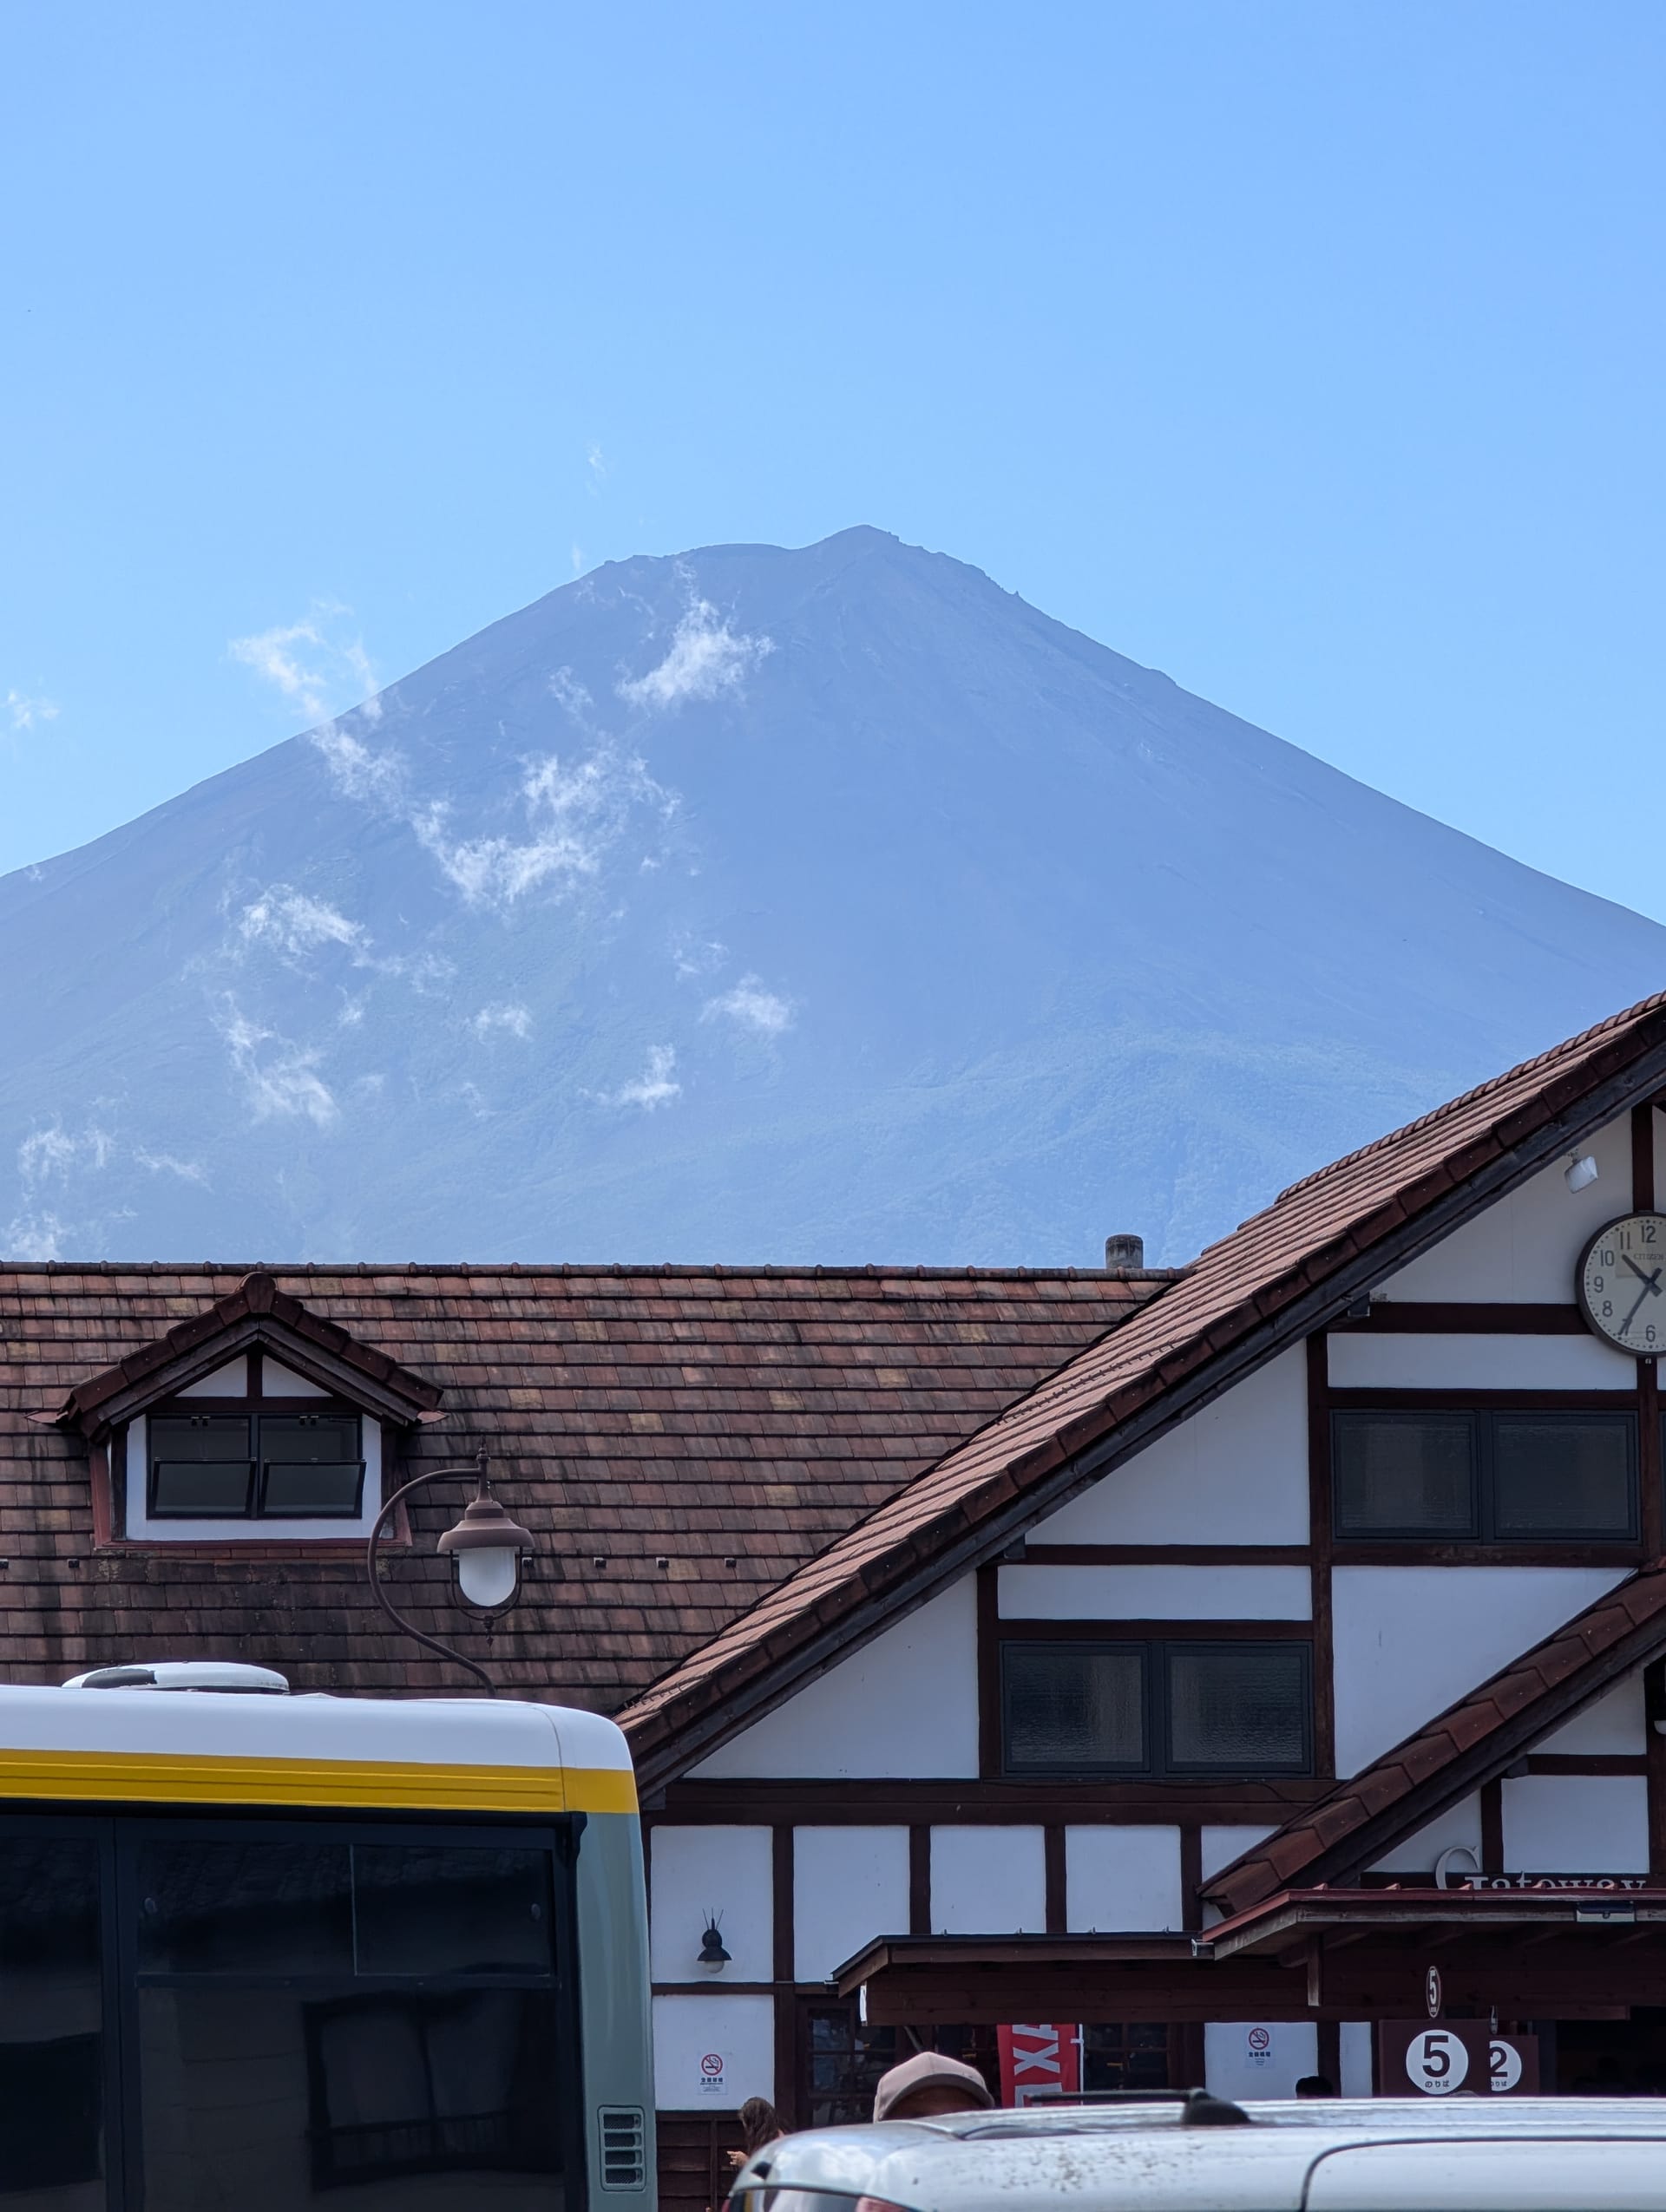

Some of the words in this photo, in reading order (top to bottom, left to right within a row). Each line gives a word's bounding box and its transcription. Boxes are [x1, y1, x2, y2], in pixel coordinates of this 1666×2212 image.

[1619, 1231, 1630, 1250] 11
[1641, 1225, 1656, 1243] 12
[1600, 1249, 1615, 1266] 10
[1593, 1276, 1604, 1293] 9
[1602, 1300, 1613, 1318] 8
[1645, 1325, 1656, 1342] 6
[1429, 1970, 1437, 2006] 5
[1422, 2035, 1450, 2078] 5
[1489, 2046, 1508, 2078] 2
